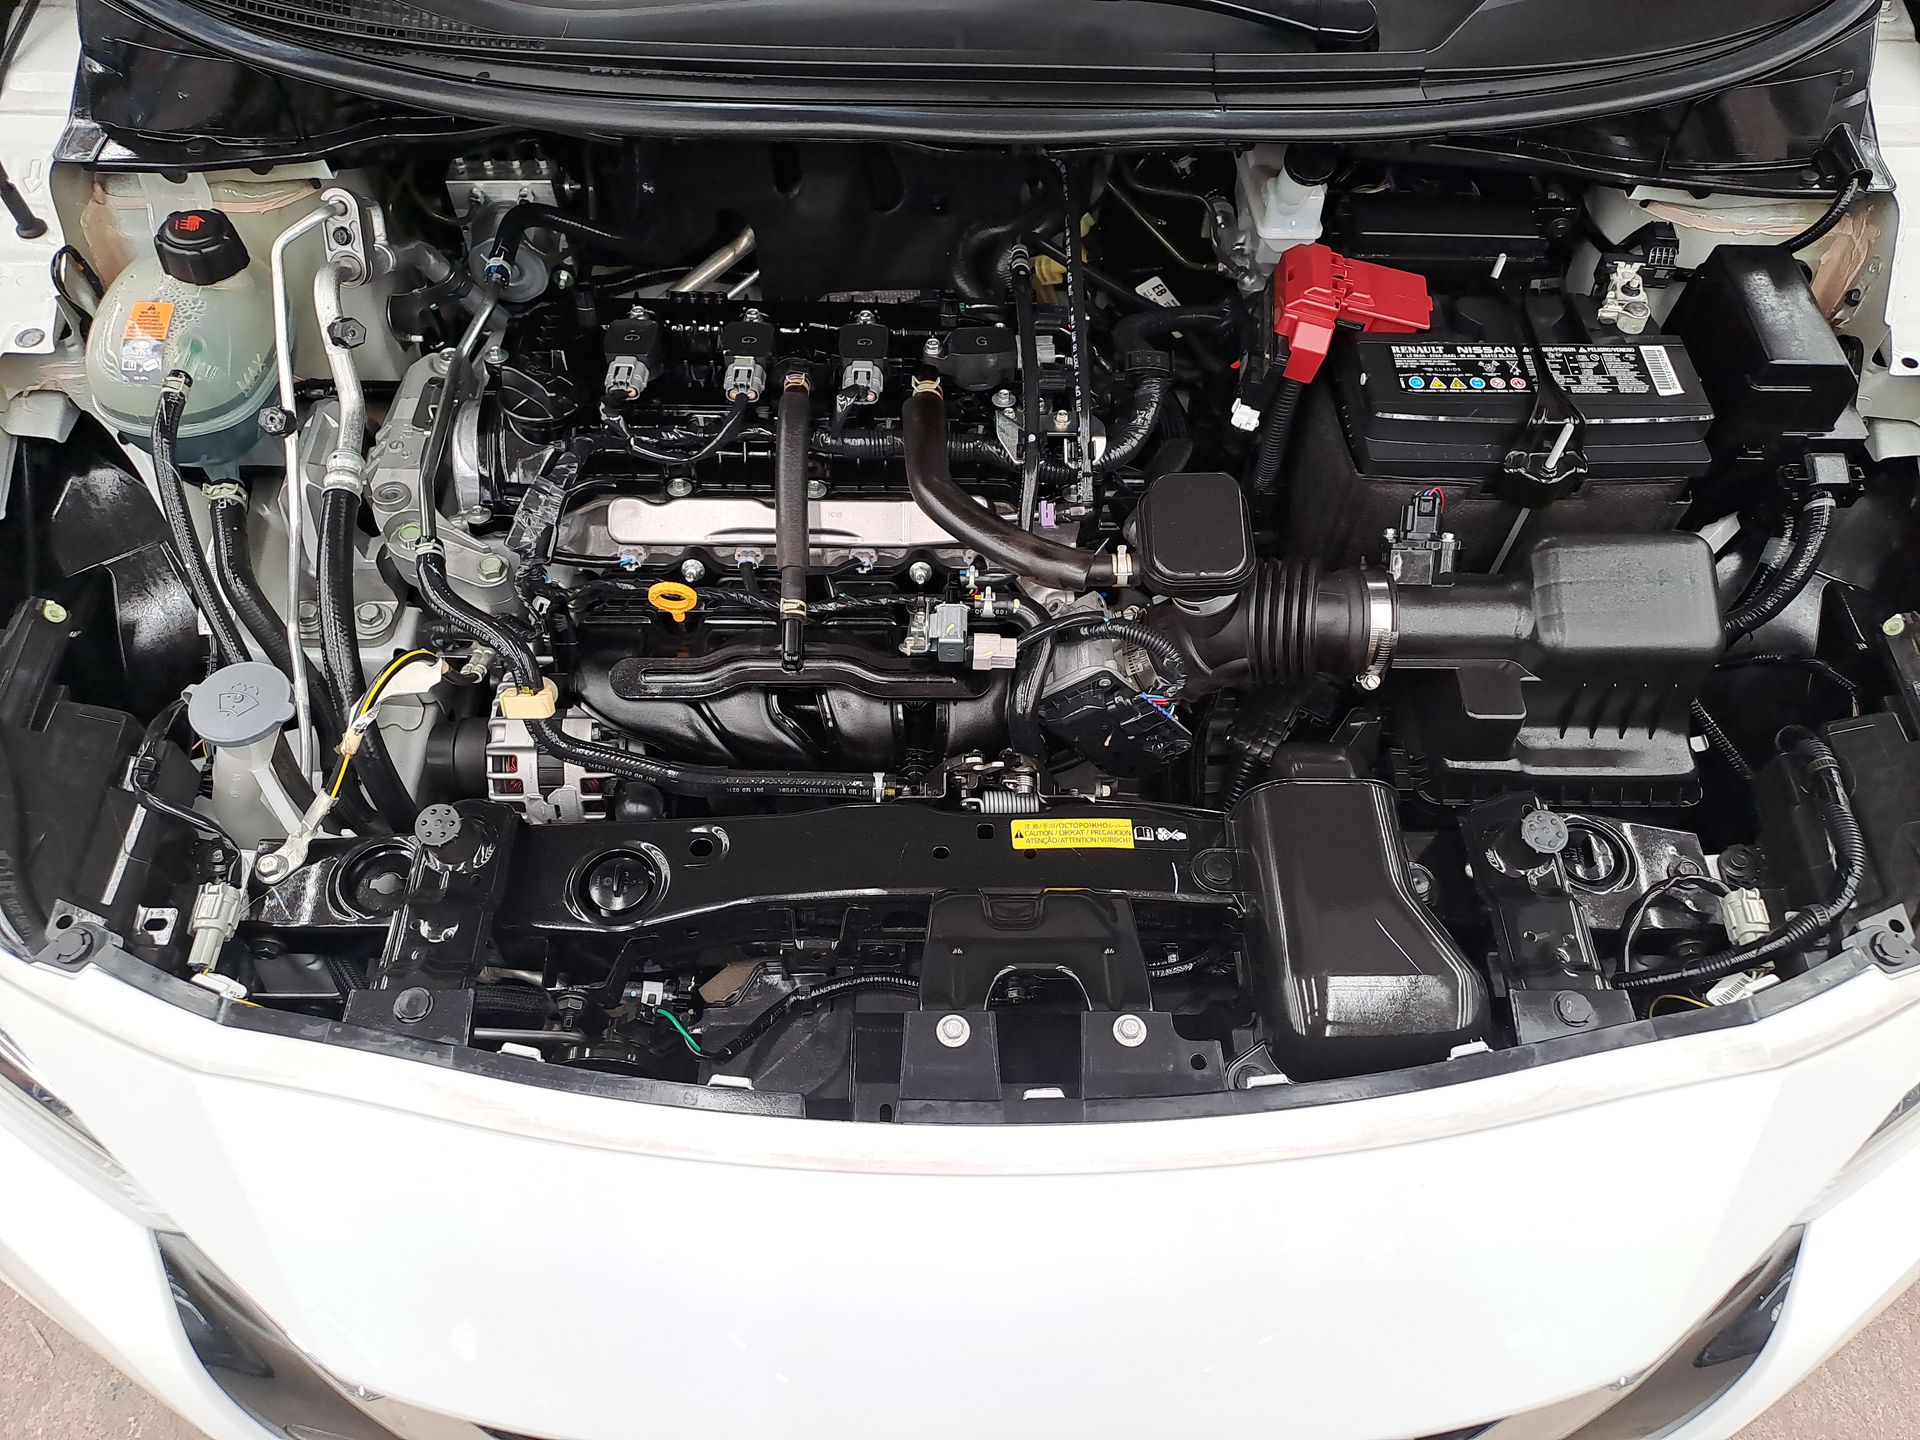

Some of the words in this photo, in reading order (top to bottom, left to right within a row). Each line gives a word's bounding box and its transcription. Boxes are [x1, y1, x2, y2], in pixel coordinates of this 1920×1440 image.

[1152, 283, 1167, 296] EB
[976, 336, 988, 346] G
[1391, 345, 1444, 354] RENAULT
[1456, 346, 1516, 354] NISSAN
